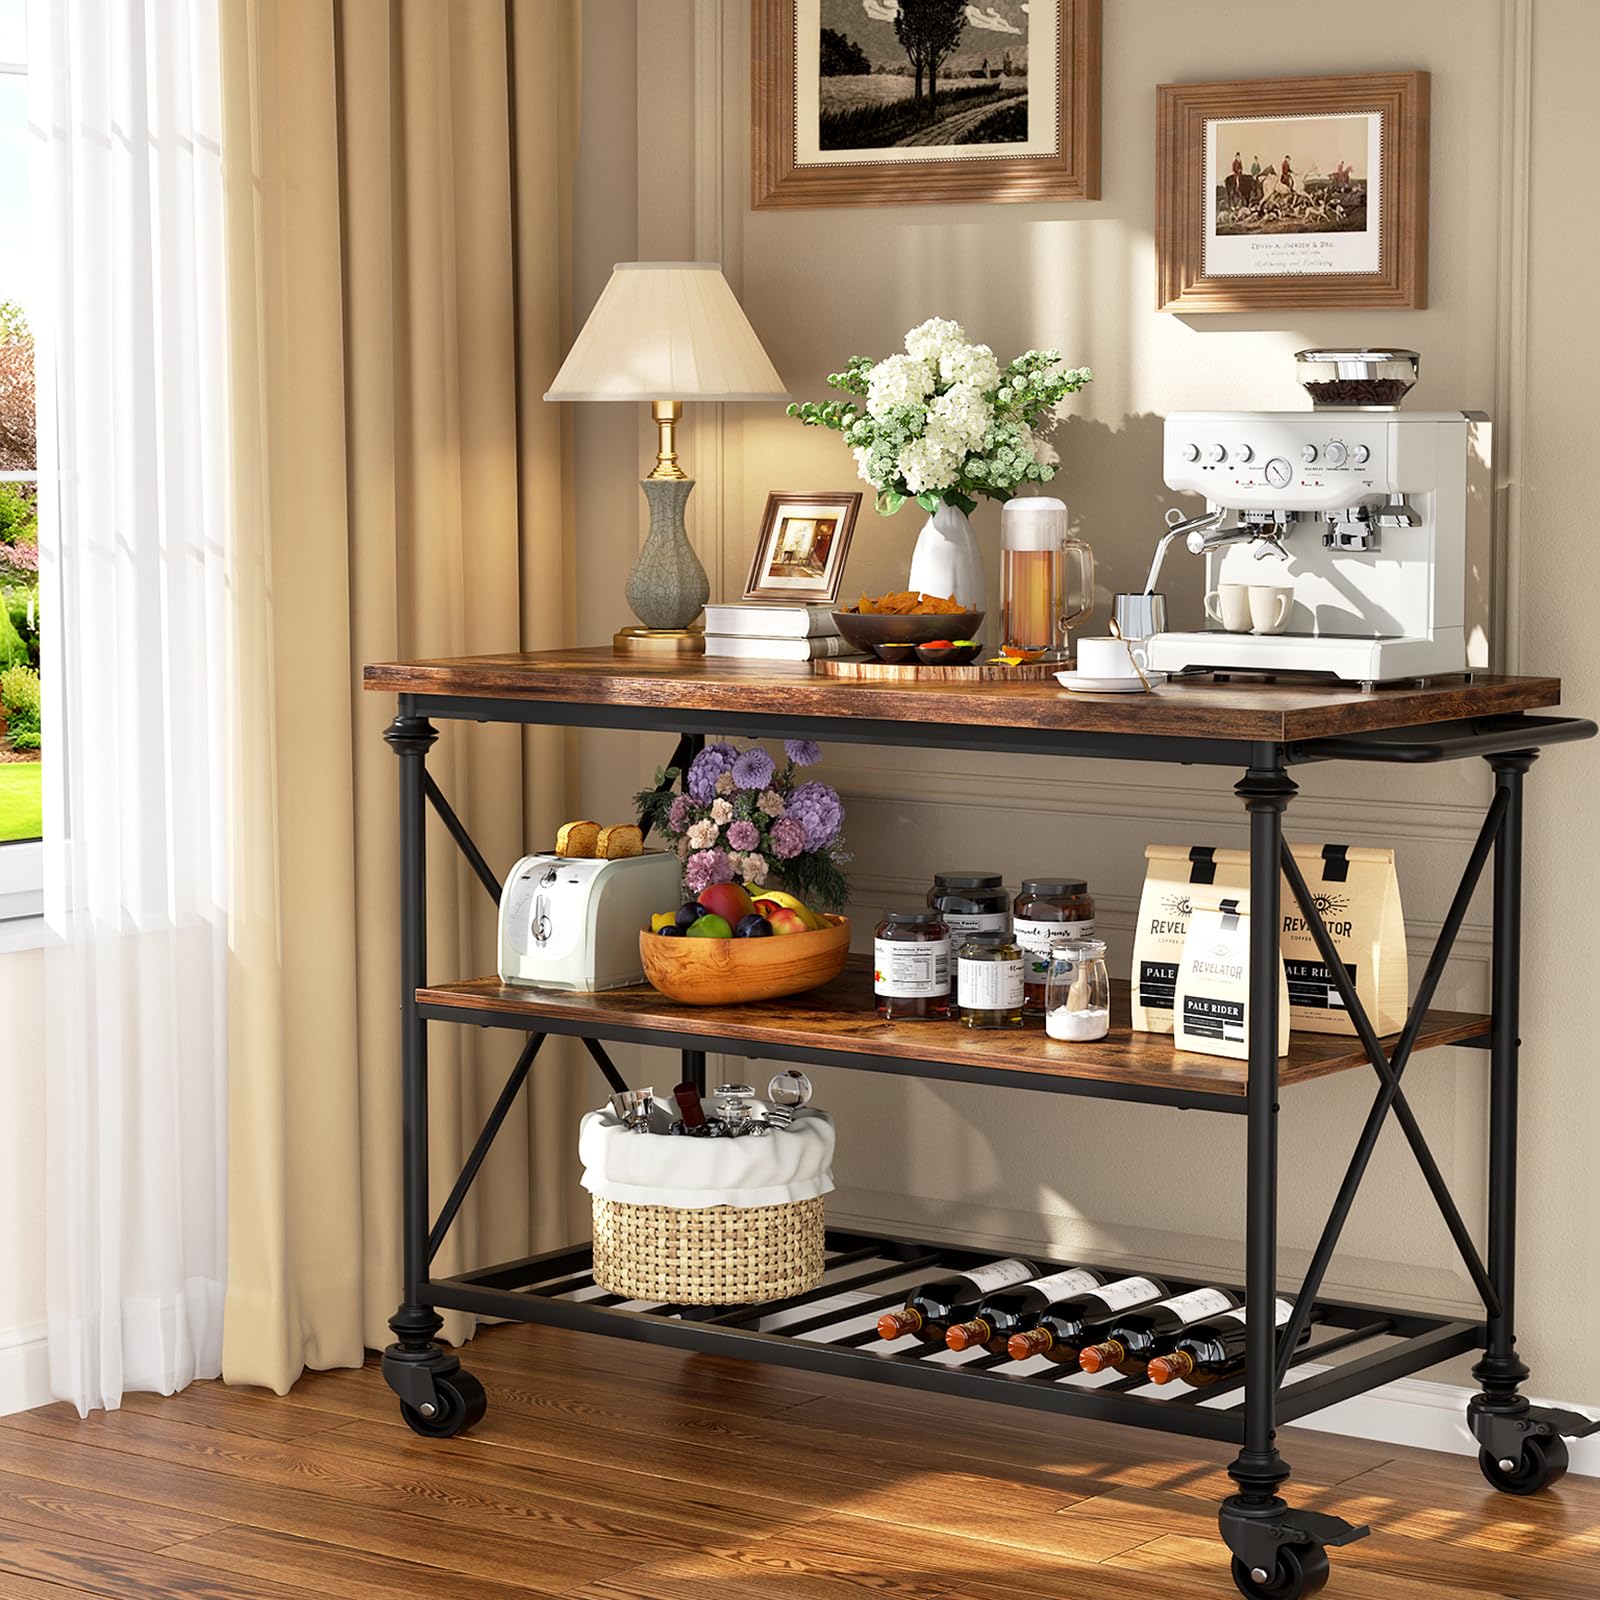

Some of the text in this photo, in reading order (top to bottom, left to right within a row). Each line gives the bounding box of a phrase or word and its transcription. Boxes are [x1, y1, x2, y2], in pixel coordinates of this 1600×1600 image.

[1151, 919, 1186, 935] REVEL
[1146, 967, 1175, 979] PALE
[1192, 960, 1243, 980] REVELATOR
[1286, 966, 1332, 978] ALE RID
[1188, 1001, 1239, 1016] PALE RIDER
